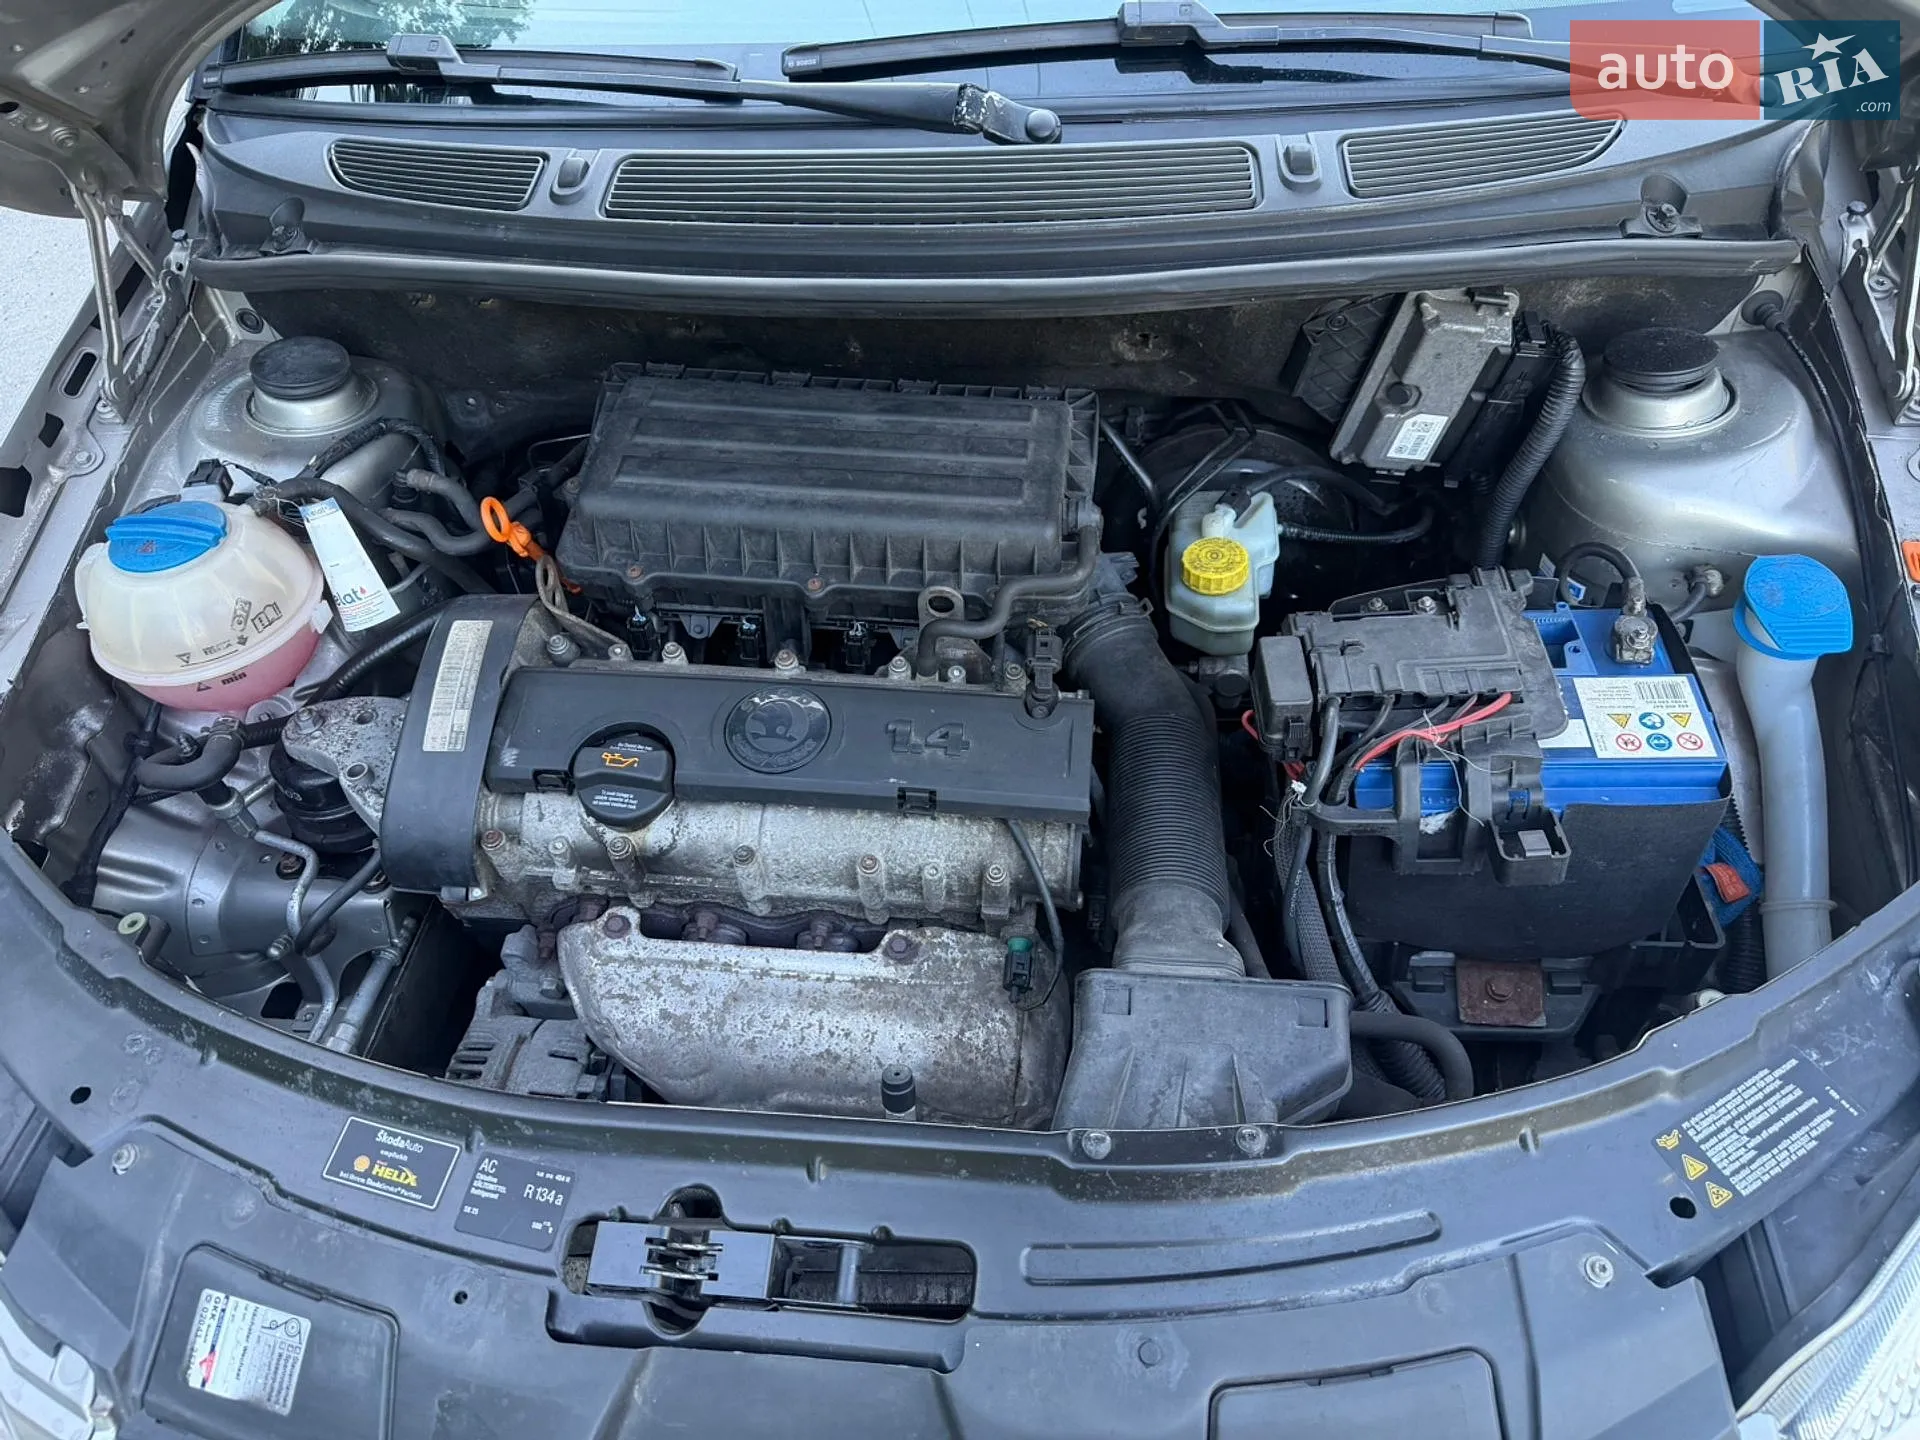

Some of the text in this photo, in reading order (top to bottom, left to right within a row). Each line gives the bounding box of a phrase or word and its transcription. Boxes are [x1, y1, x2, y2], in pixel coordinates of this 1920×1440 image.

[221, 672, 247, 686] min
[885, 719, 970, 757] 1.4
[479, 1157, 498, 1173] AC
[372, 1164, 418, 1187] HELIX
